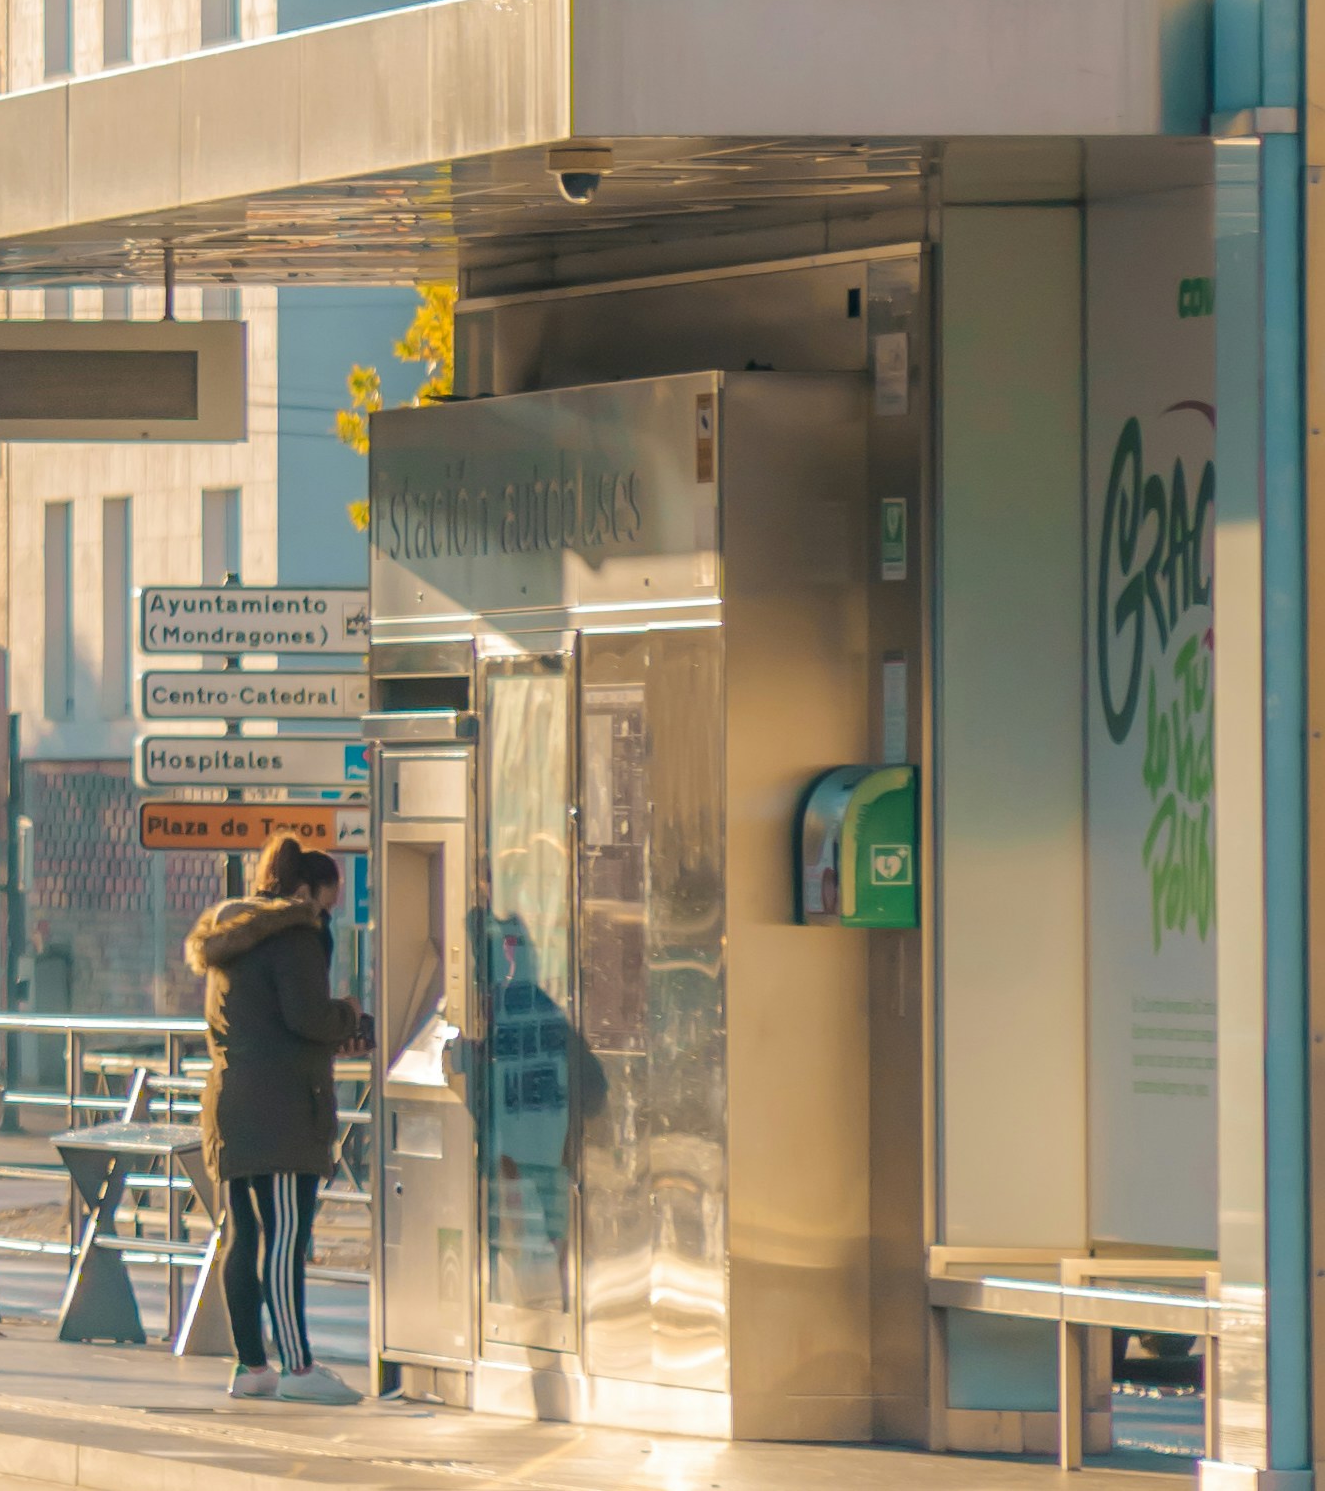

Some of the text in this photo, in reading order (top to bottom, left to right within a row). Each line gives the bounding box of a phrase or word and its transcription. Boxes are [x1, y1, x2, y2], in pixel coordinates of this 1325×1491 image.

[501, 449, 641, 554] autobuses
[150, 594, 328, 617] Ayuntamiento
[149, 625, 329, 647] (Mondragones)
[152, 686, 339, 706] Centro-Catedral
[150, 750, 283, 773] Hospitales
[148, 816, 209, 837] Plaza
[221, 816, 249, 837] de
